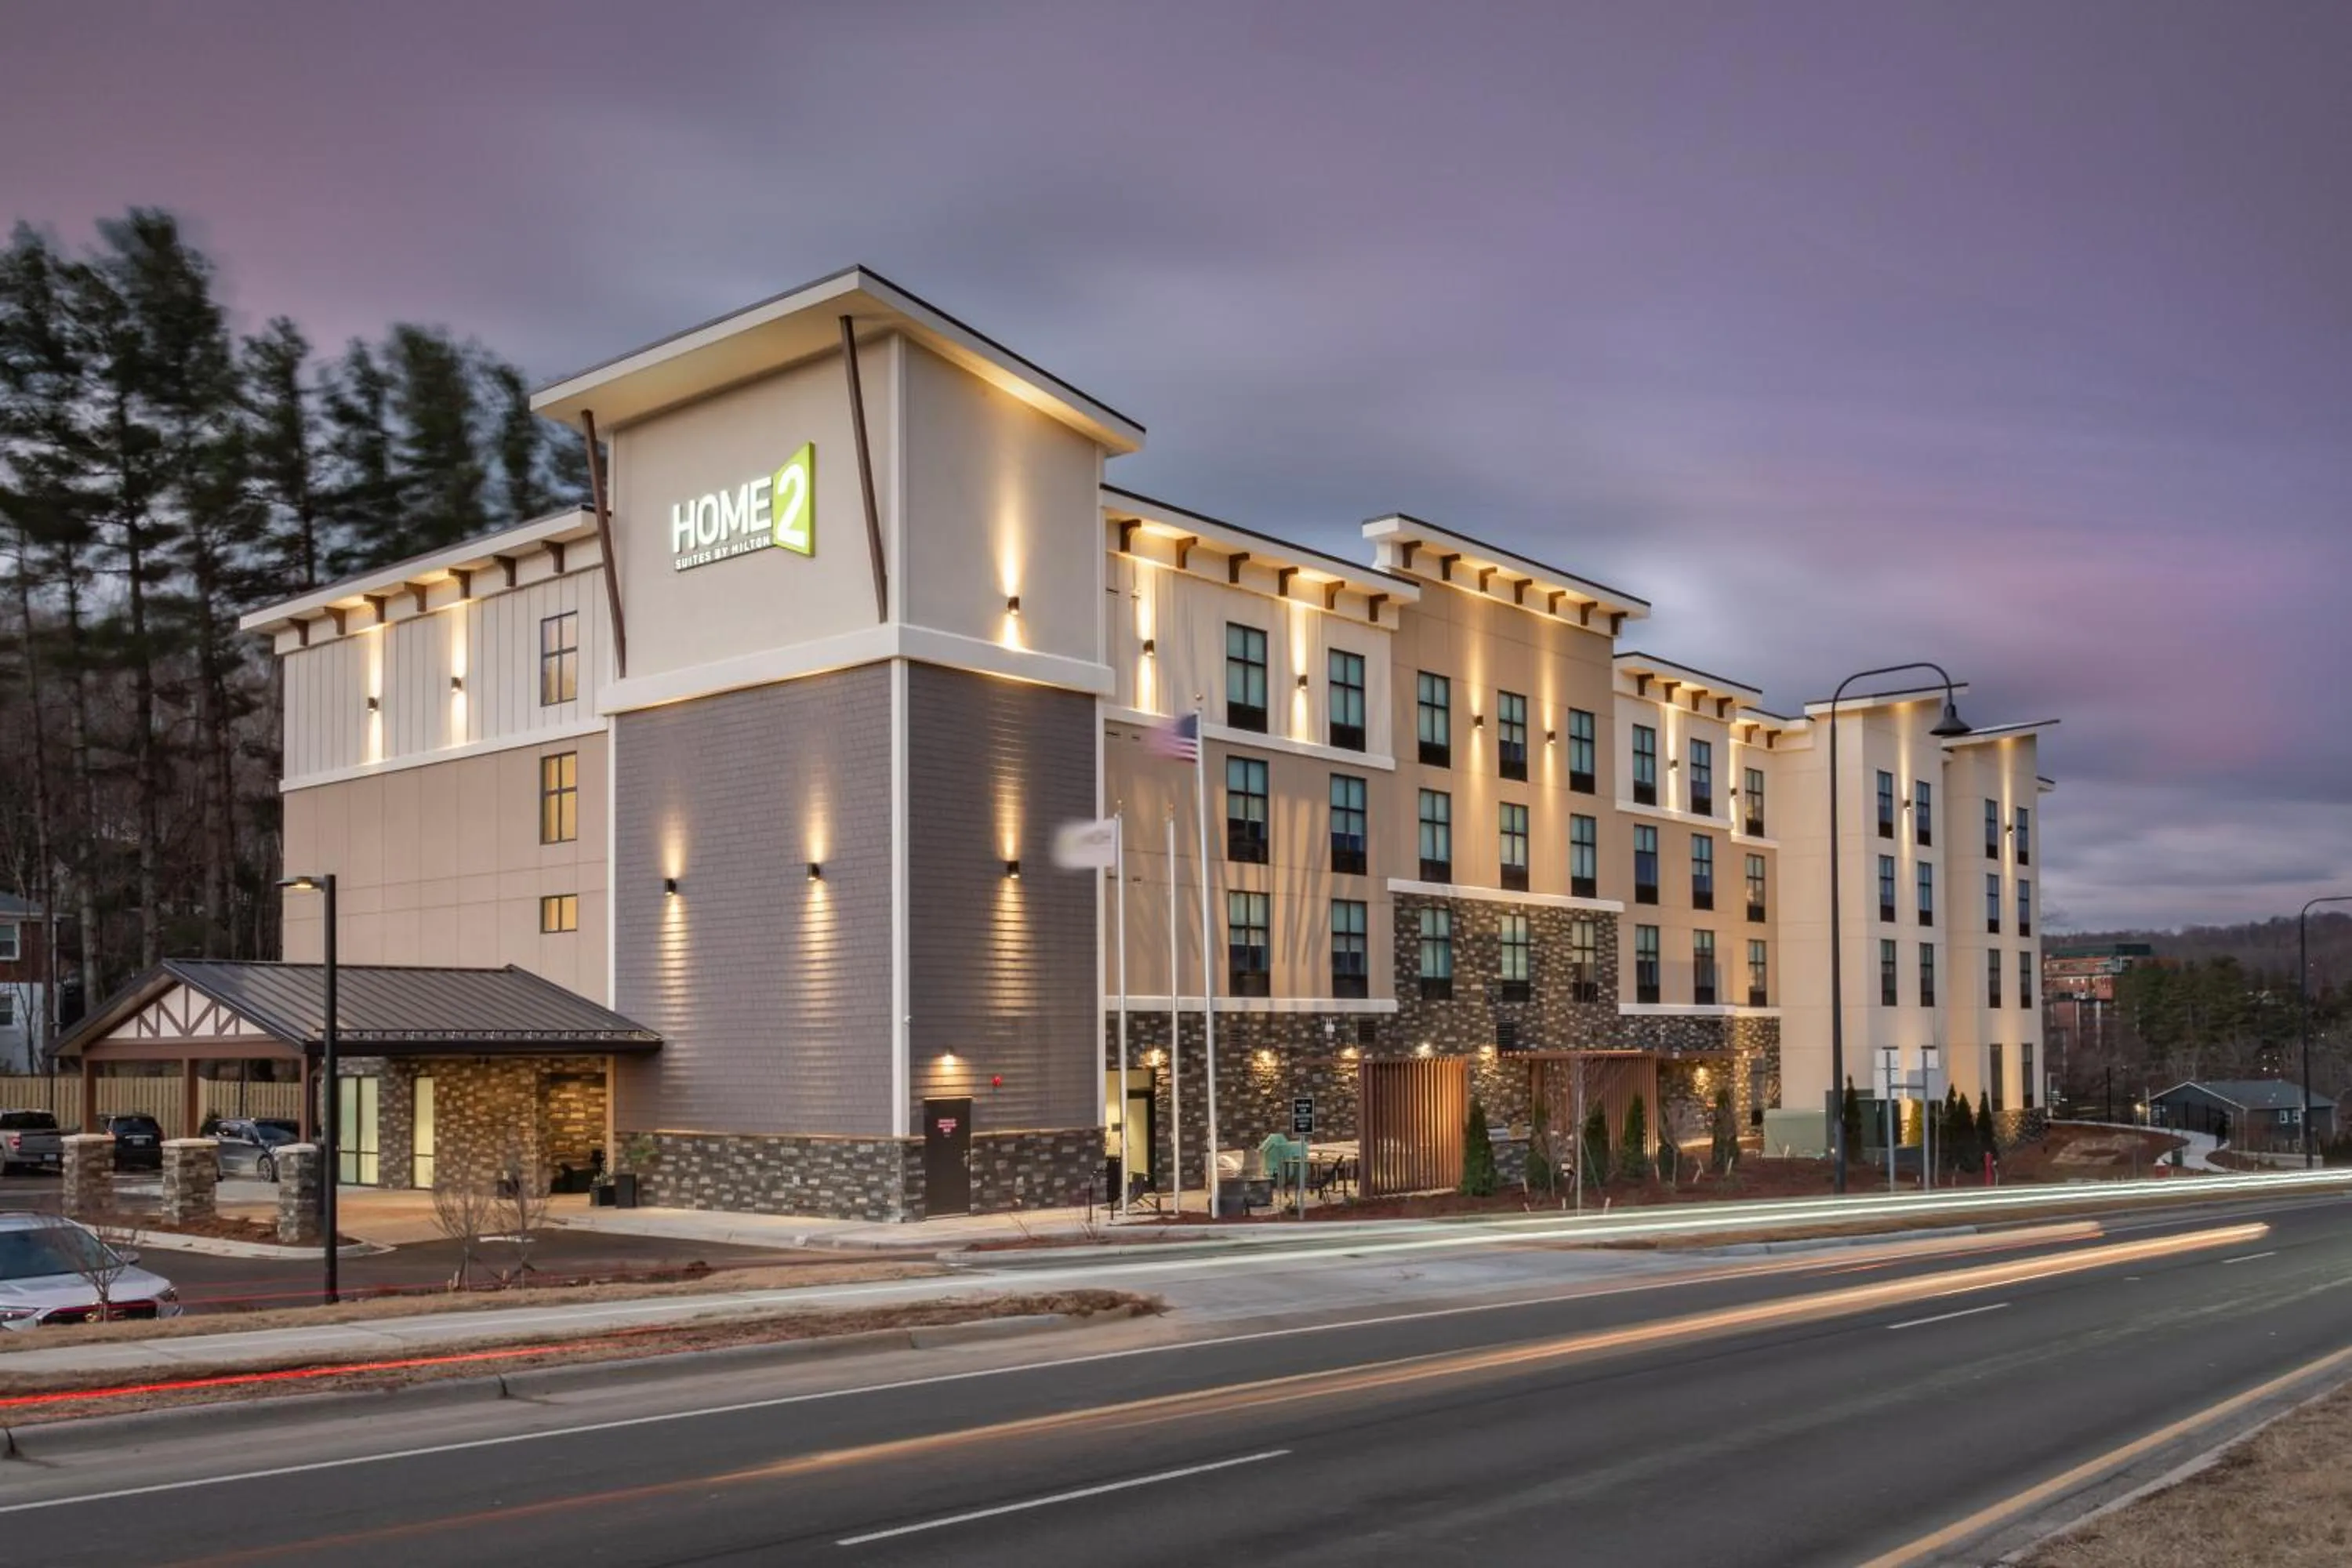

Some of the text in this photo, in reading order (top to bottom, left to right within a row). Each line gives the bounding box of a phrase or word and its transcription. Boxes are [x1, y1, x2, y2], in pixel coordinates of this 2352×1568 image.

[673, 463, 806, 553] HOME 2
[674, 535, 771, 570] SUITES BY HILTON
